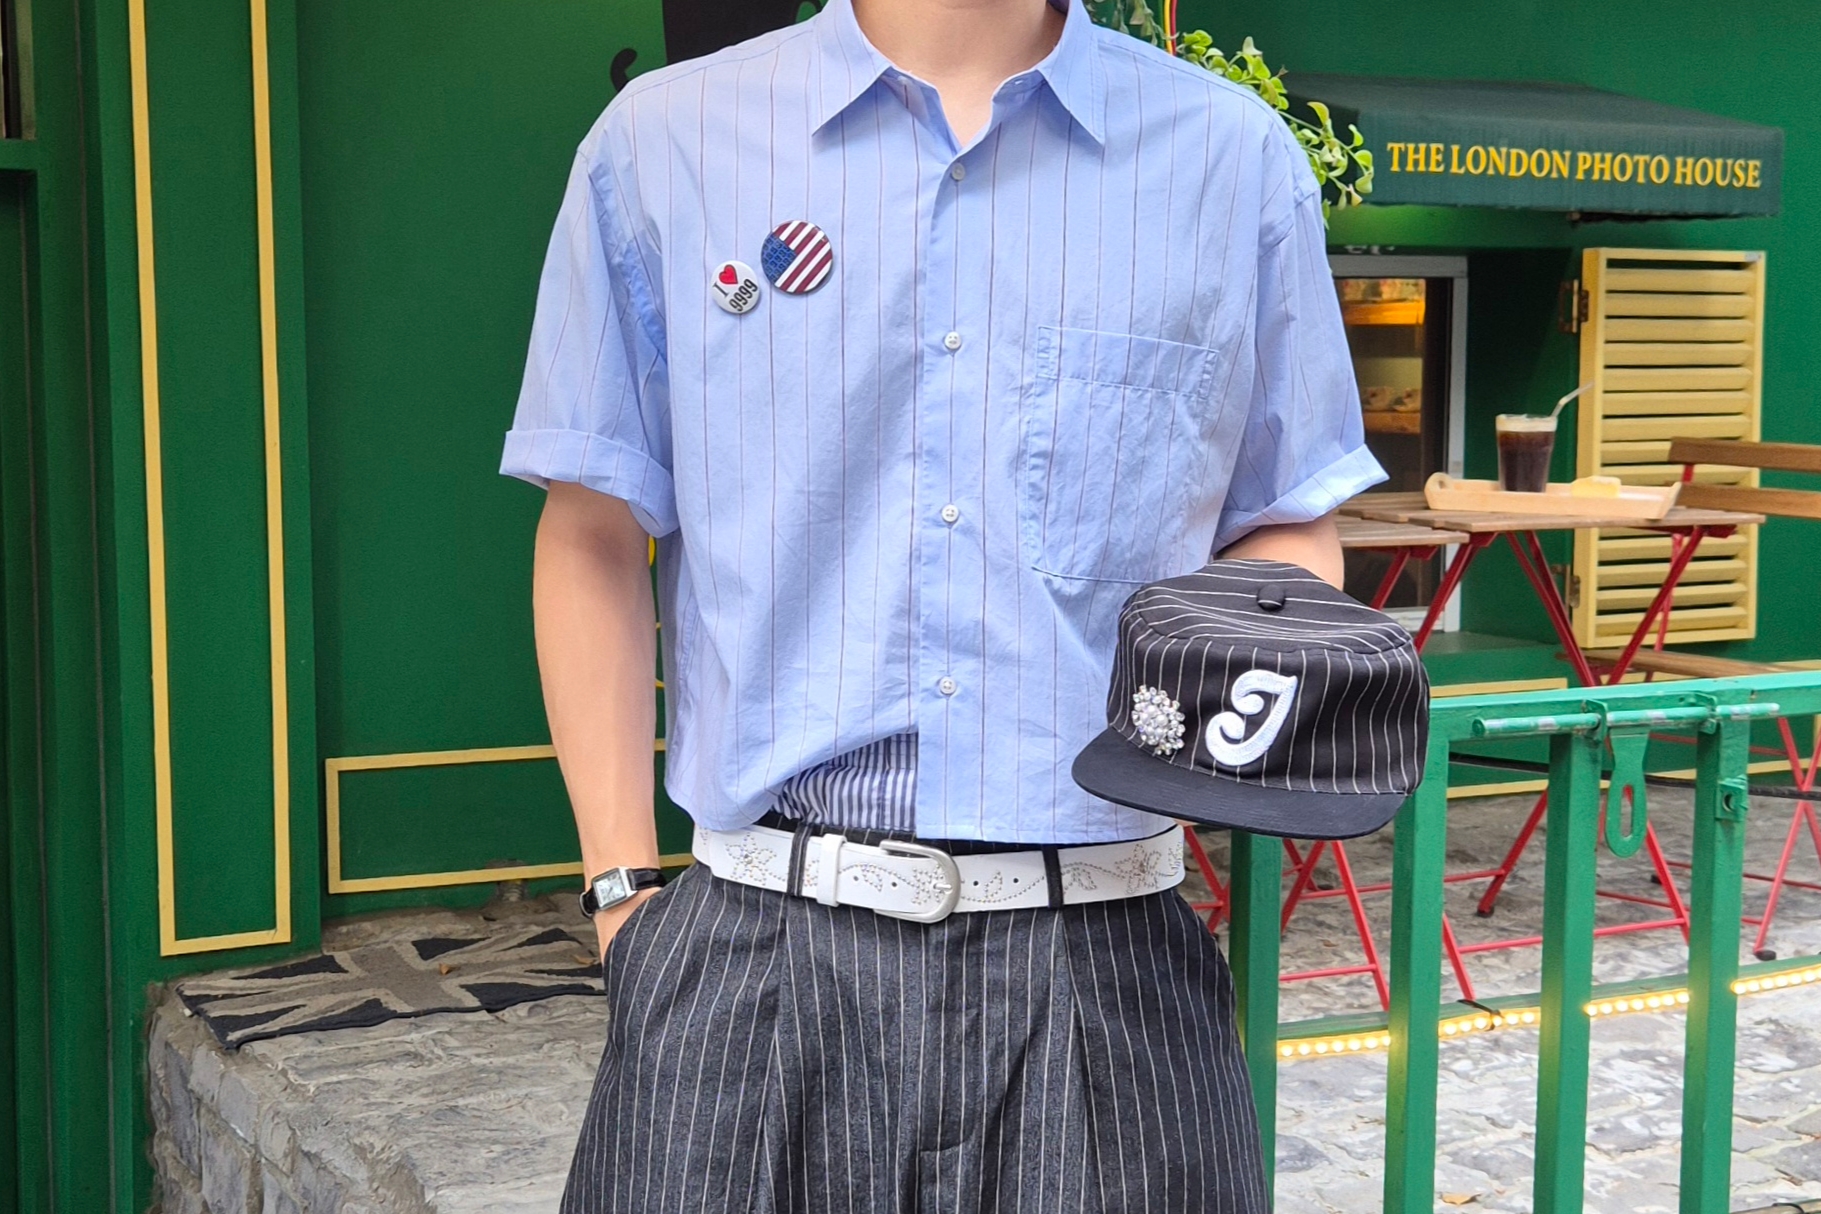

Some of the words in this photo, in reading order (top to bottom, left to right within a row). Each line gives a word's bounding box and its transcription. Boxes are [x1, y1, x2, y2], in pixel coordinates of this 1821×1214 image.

[1387, 141, 1445, 174] THE
[1450, 144, 1571, 179] LONDON
[1576, 151, 1670, 184] PHOTO
[1674, 156, 1761, 188] HOUSE
[712, 281, 730, 298] I
[728, 278, 758, 312] 9999
